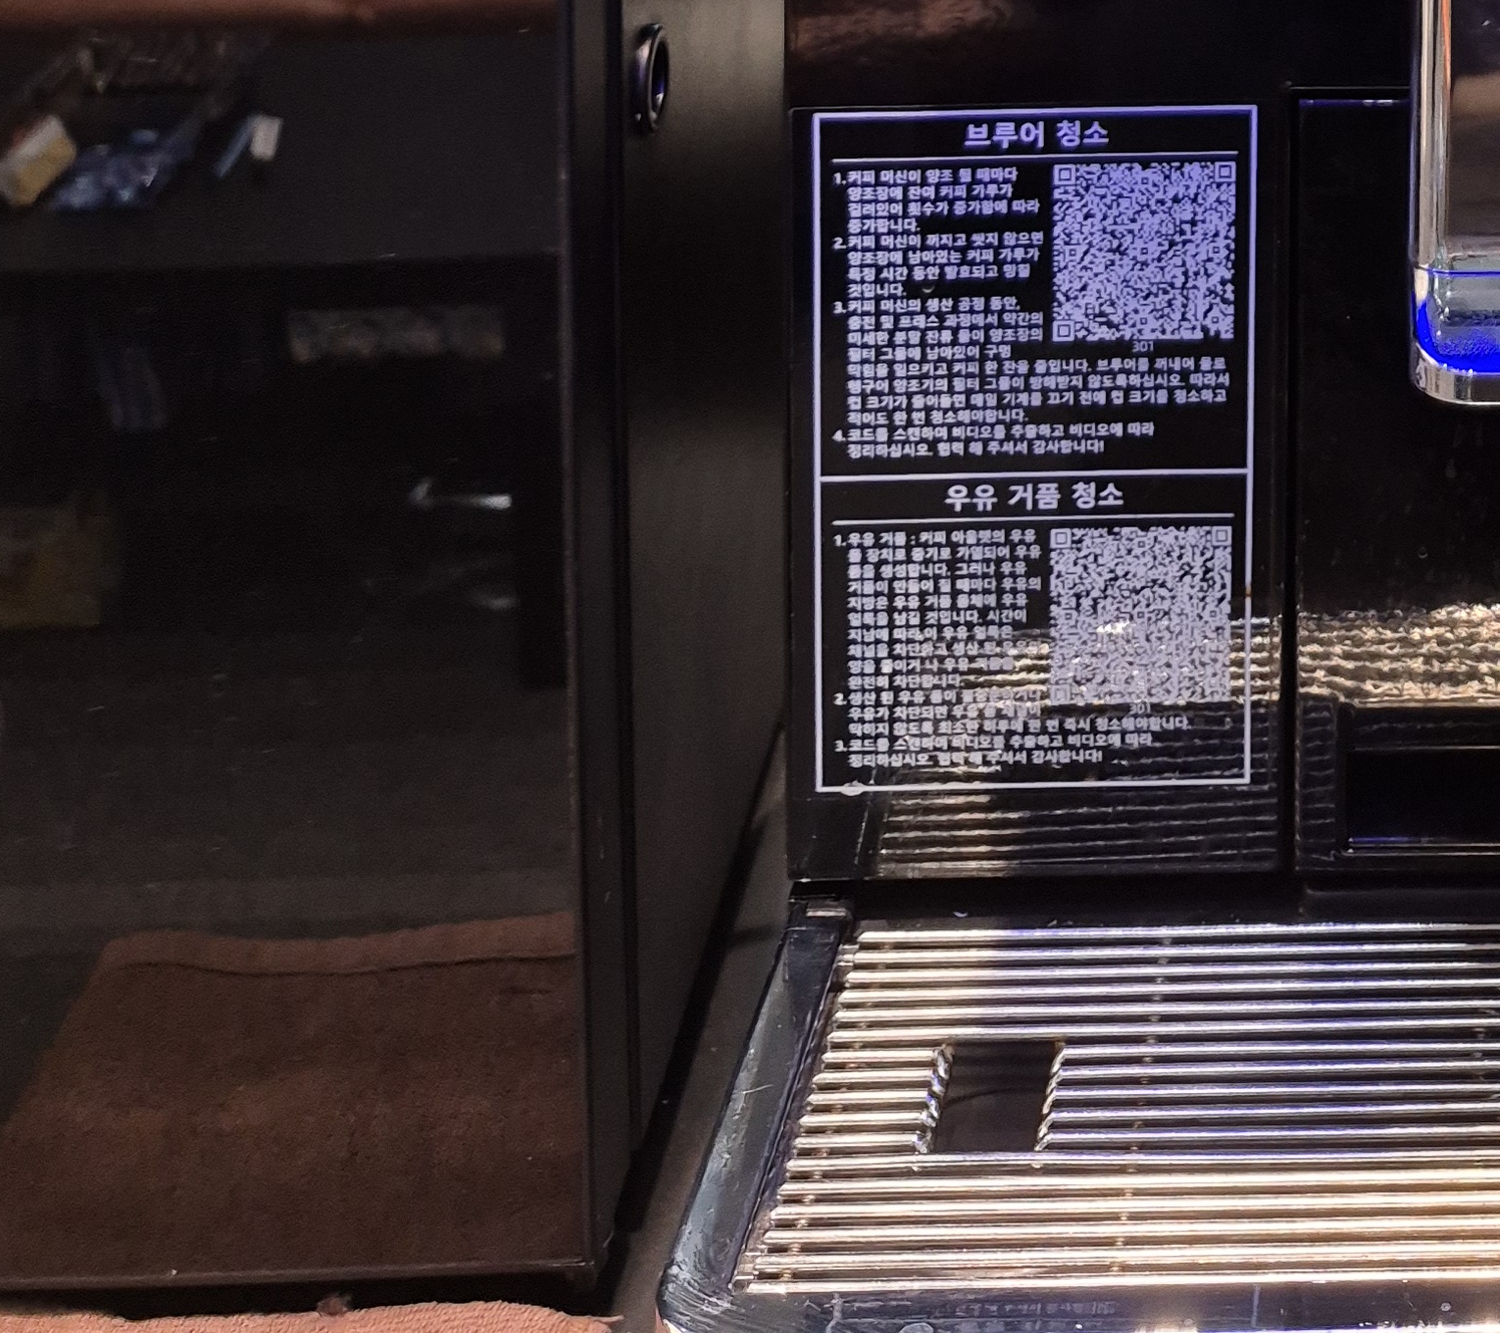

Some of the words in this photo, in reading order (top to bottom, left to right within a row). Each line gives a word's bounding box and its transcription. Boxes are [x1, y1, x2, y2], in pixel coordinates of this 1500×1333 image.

[964, 122, 1045, 149] 브루어
[1057, 120, 1109, 148] 청소
[879, 265, 907, 280] 시간
[848, 281, 905, 296] 것입니다.
[1132, 341, 1154, 352] 301
[945, 485, 997, 511] 우유
[1008, 483, 1060, 510] 거품
[1072, 481, 1124, 509] 청소
